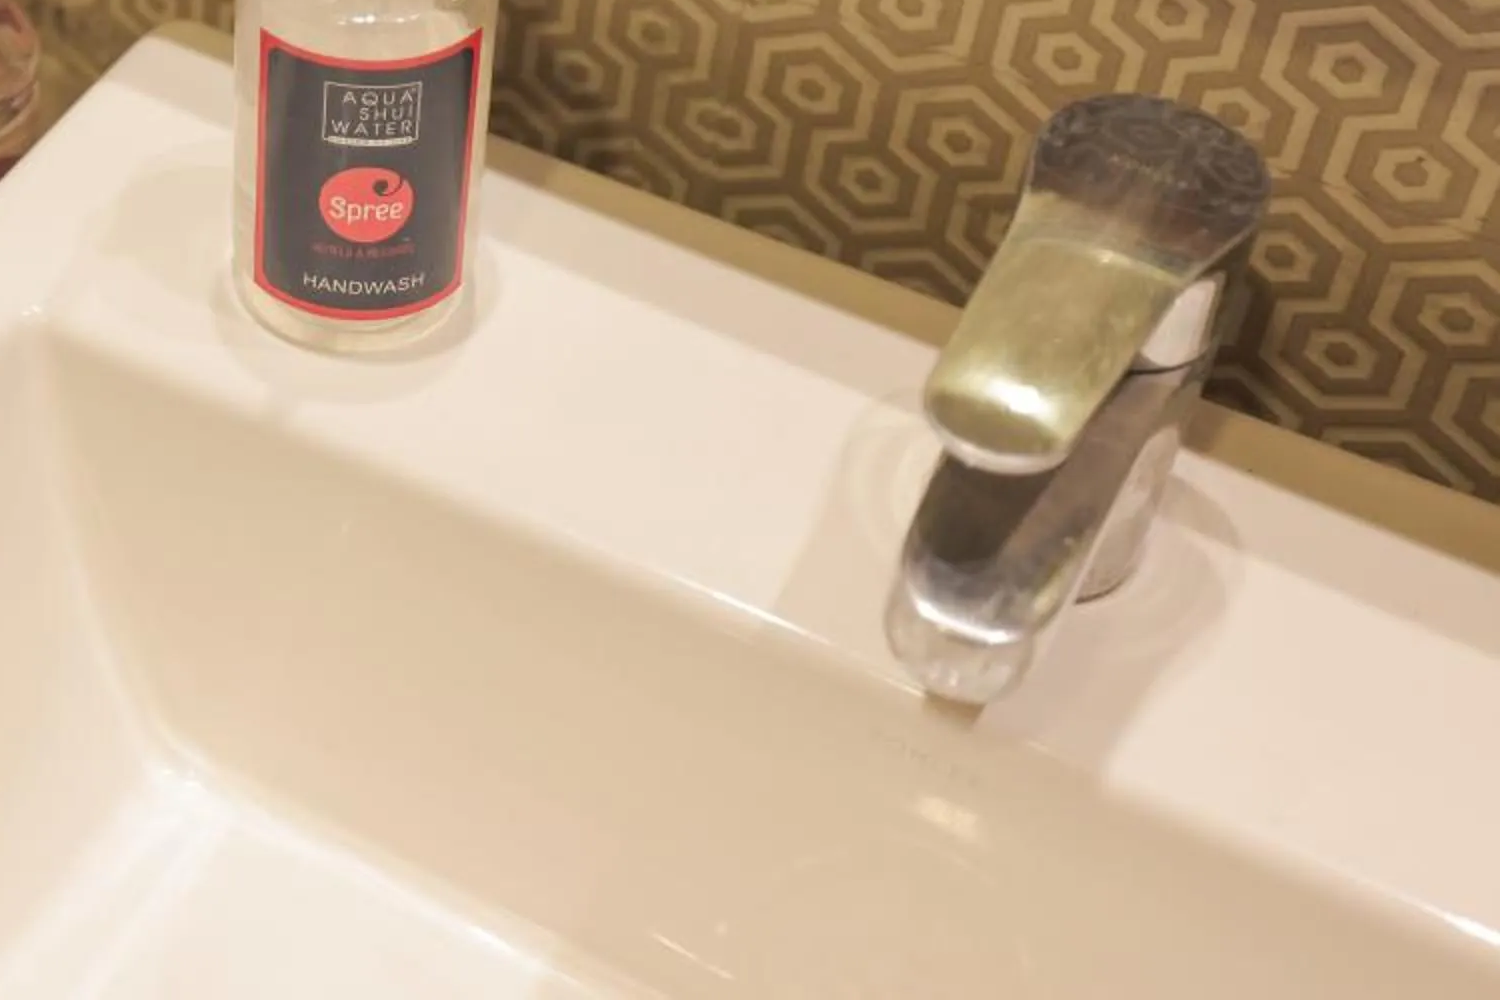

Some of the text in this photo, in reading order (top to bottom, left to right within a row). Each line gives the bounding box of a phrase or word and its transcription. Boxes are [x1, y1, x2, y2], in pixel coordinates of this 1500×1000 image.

[343, 90, 413, 105] AQUA
[360, 105, 413, 120] SHUI
[332, 119, 413, 136] WATER
[329, 196, 404, 225] Spree
[303, 272, 425, 295] HANDWASH
